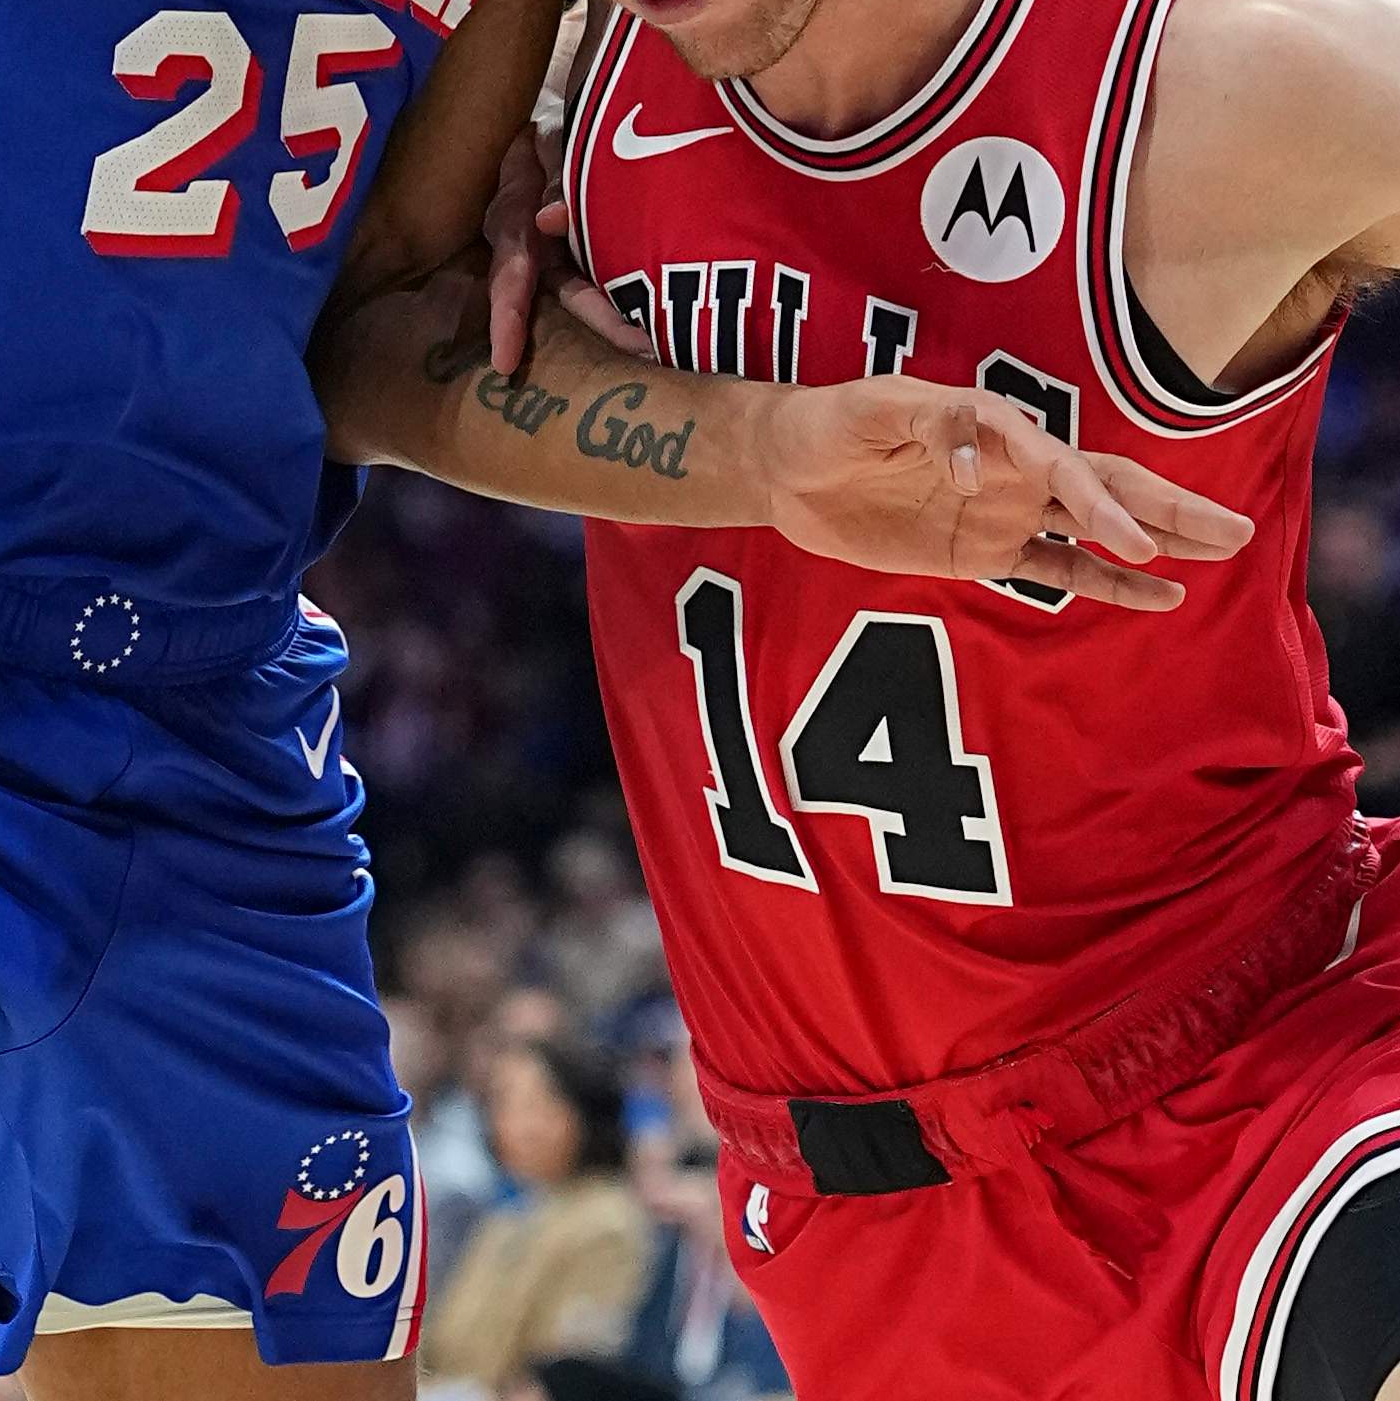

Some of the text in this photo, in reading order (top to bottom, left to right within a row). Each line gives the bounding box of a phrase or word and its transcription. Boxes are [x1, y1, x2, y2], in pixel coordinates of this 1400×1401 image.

[82, 10, 403, 258] 25
[575, 381, 696, 480] God
[675, 566, 1013, 906] 14
[263, 1173, 407, 1300] 76
